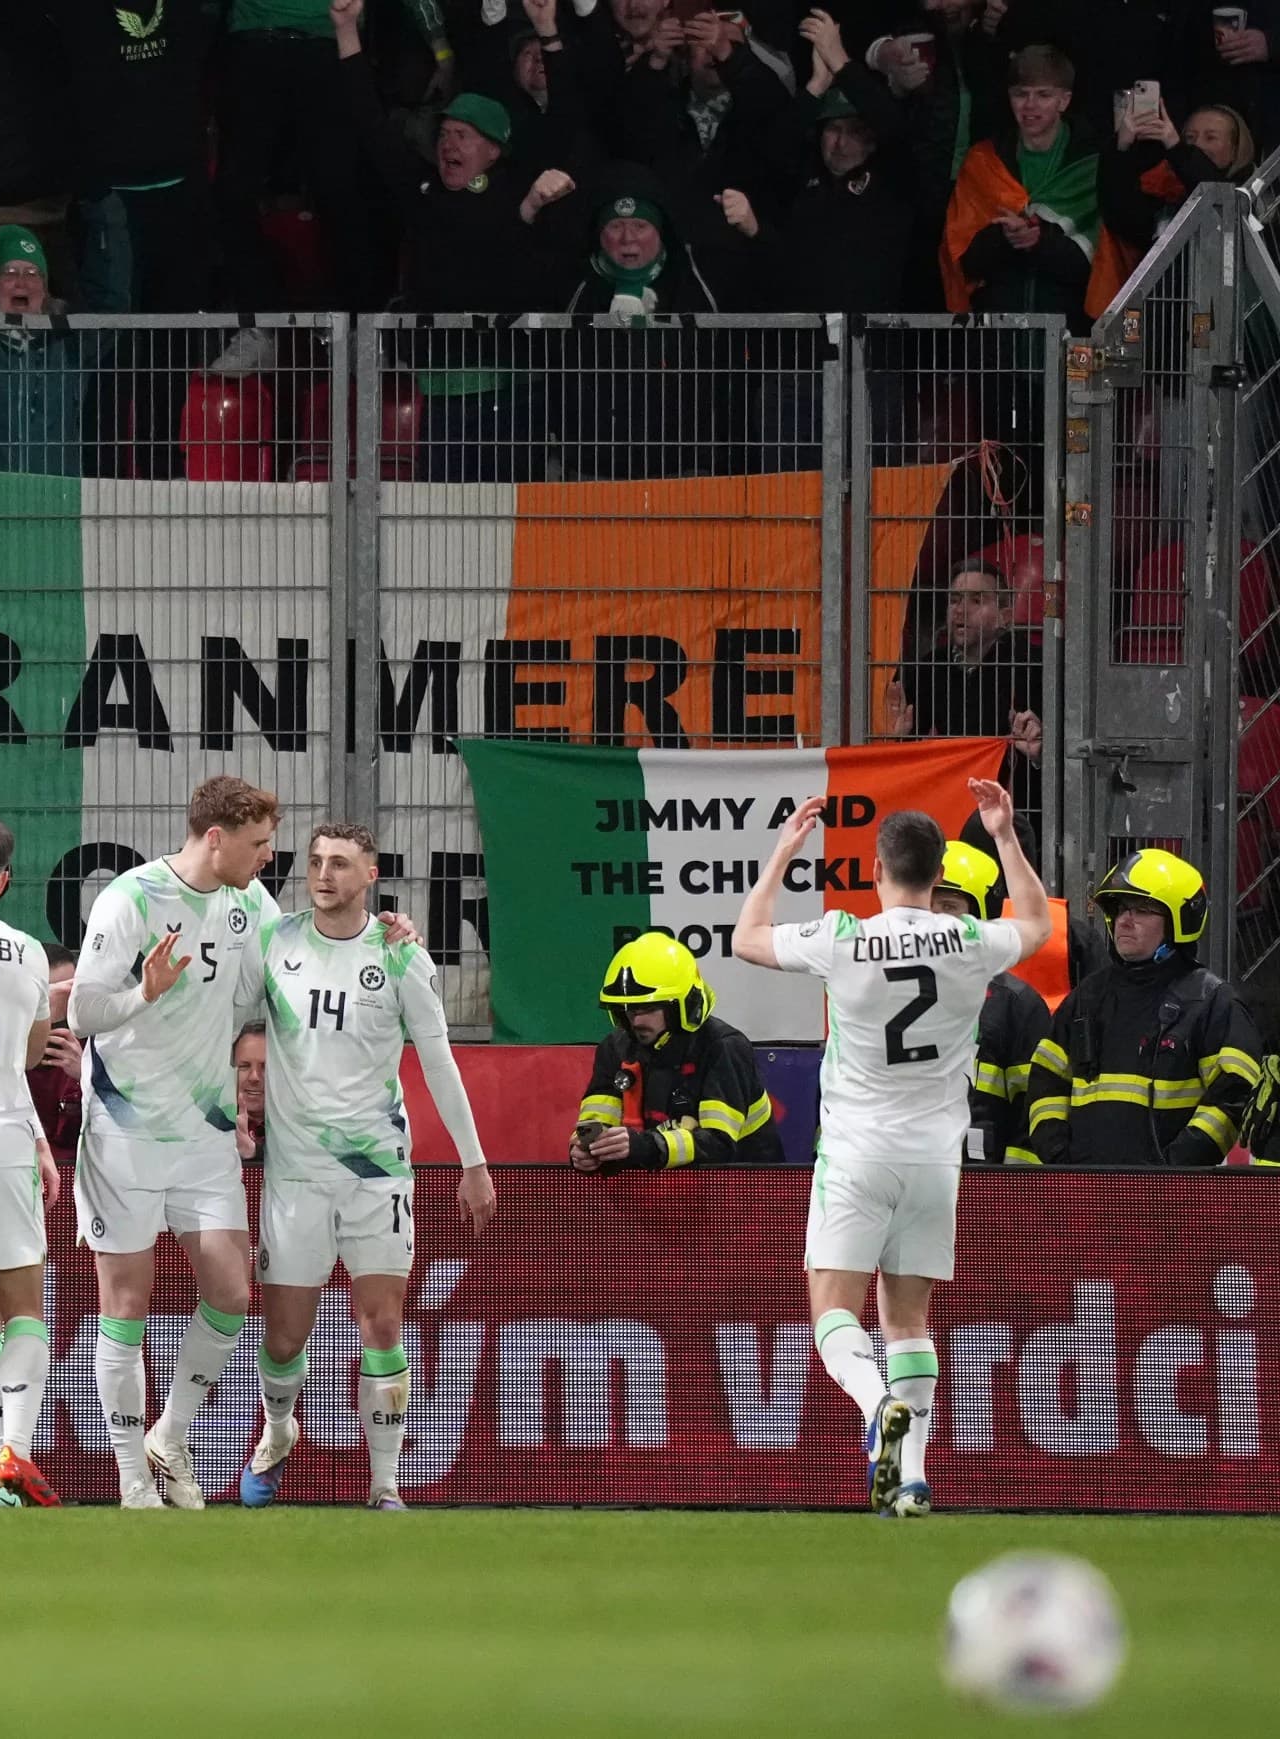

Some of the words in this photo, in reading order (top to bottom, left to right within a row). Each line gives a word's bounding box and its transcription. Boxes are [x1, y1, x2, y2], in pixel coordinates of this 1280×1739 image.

[595, 798, 756, 832] JIMMY
[767, 795, 877, 830] AND
[571, 861, 665, 896] THE
[200, 942, 218, 983] 5
[853, 927, 964, 963] COLEMAN
[308, 988, 346, 1031] 14
[883, 964, 939, 1066] 2
[717, 1322, 809, 1450] v
[866, 1264, 1260, 1457] rdci
